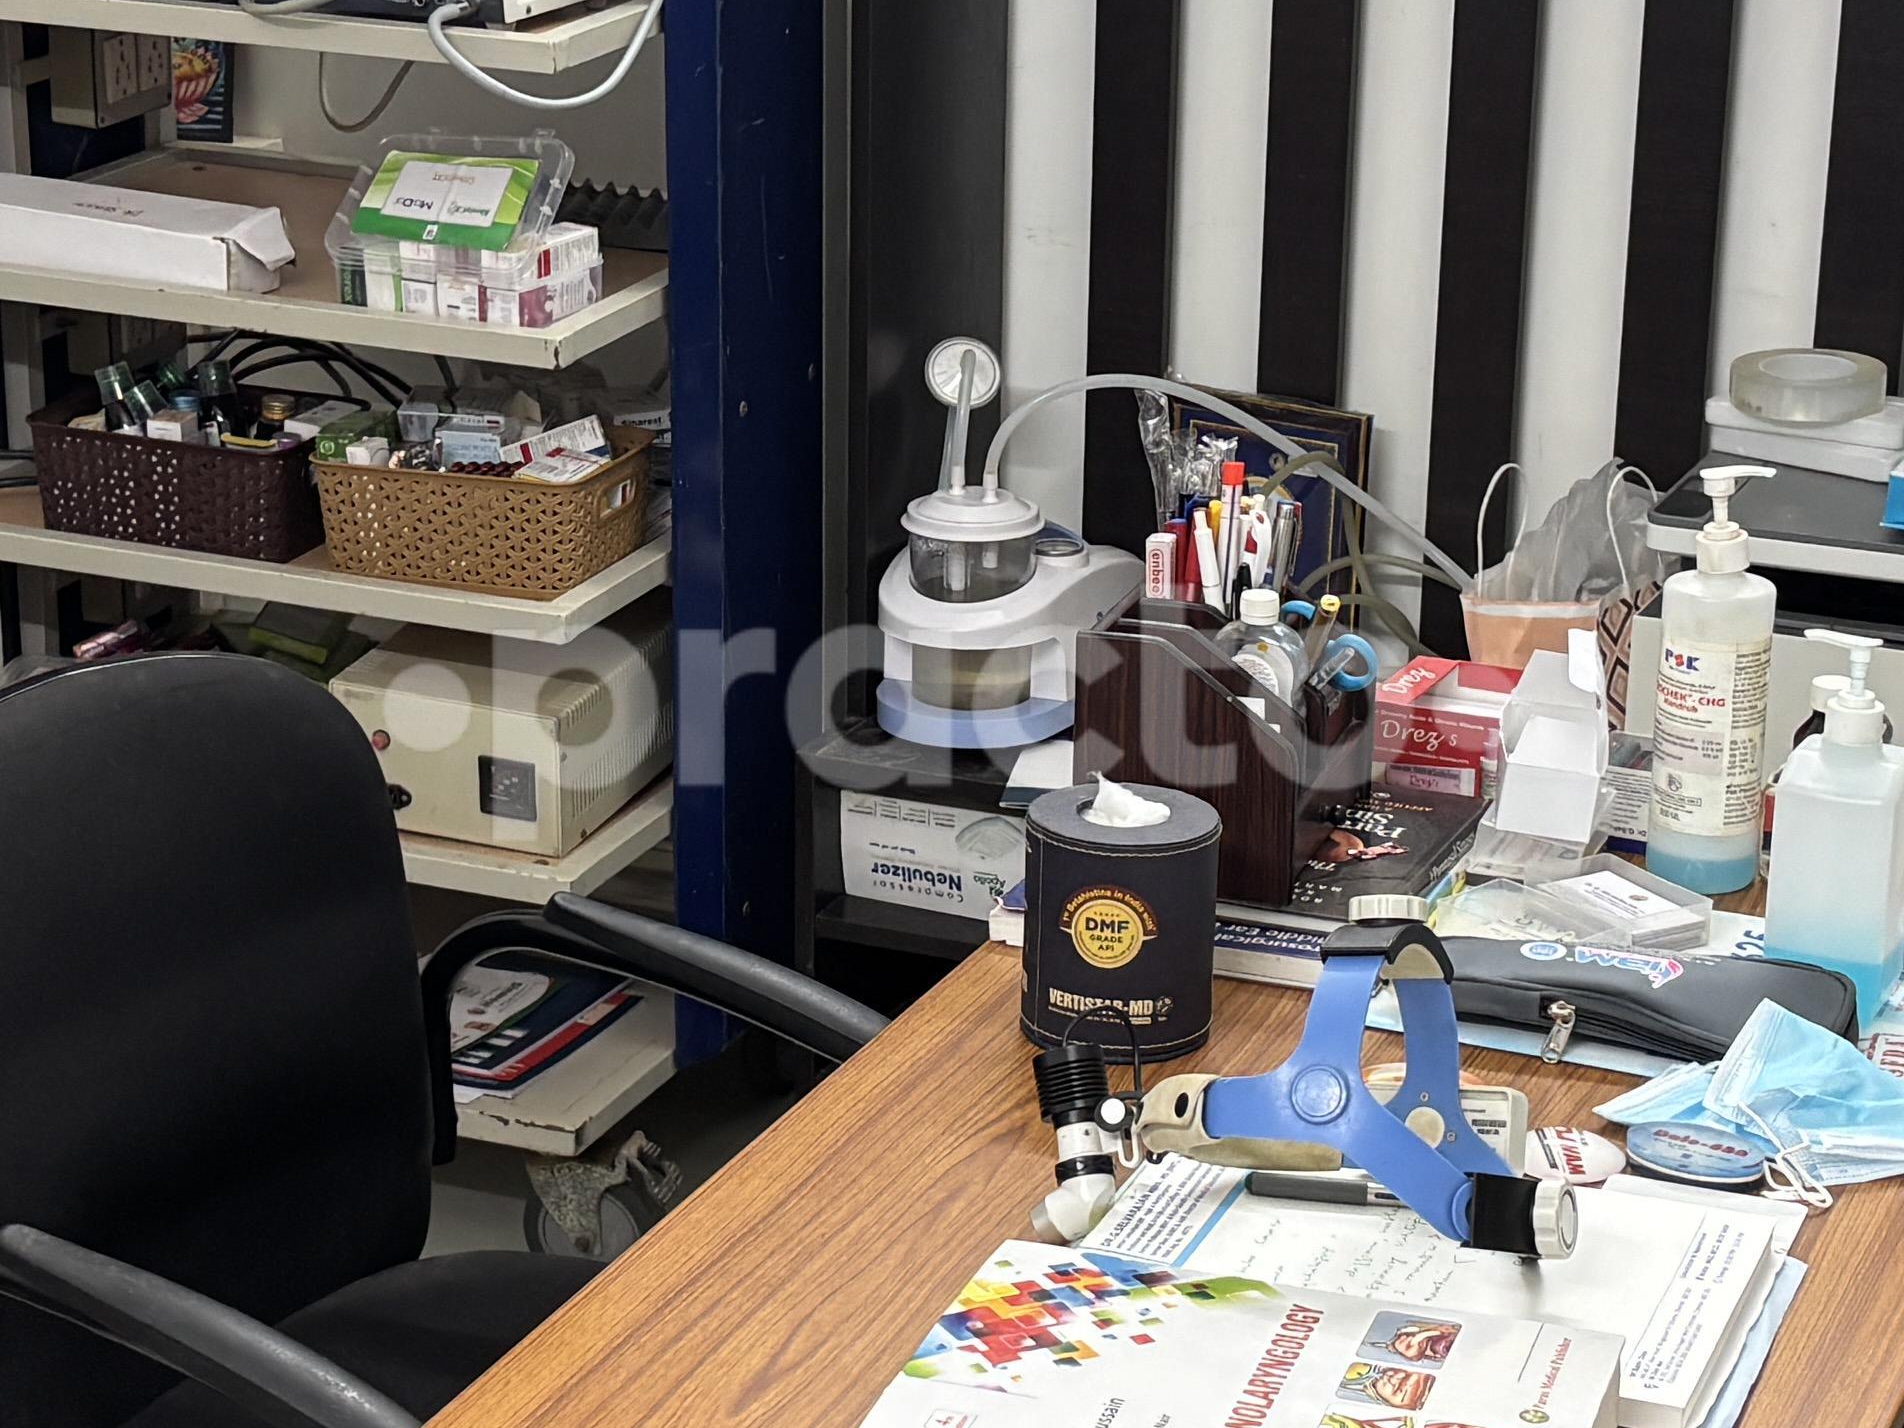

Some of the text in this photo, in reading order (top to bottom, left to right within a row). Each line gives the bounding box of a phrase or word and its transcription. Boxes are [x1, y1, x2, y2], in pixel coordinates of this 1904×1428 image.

[1380, 719, 1445, 752] Drez
[870, 861, 963, 893] Nebulizer
[1084, 916, 1131, 935] DMF
[1223, 923, 1261, 936] Ear
[1089, 934, 1124, 944] GRADE
[1214, 932, 1321, 953] rosurgical
